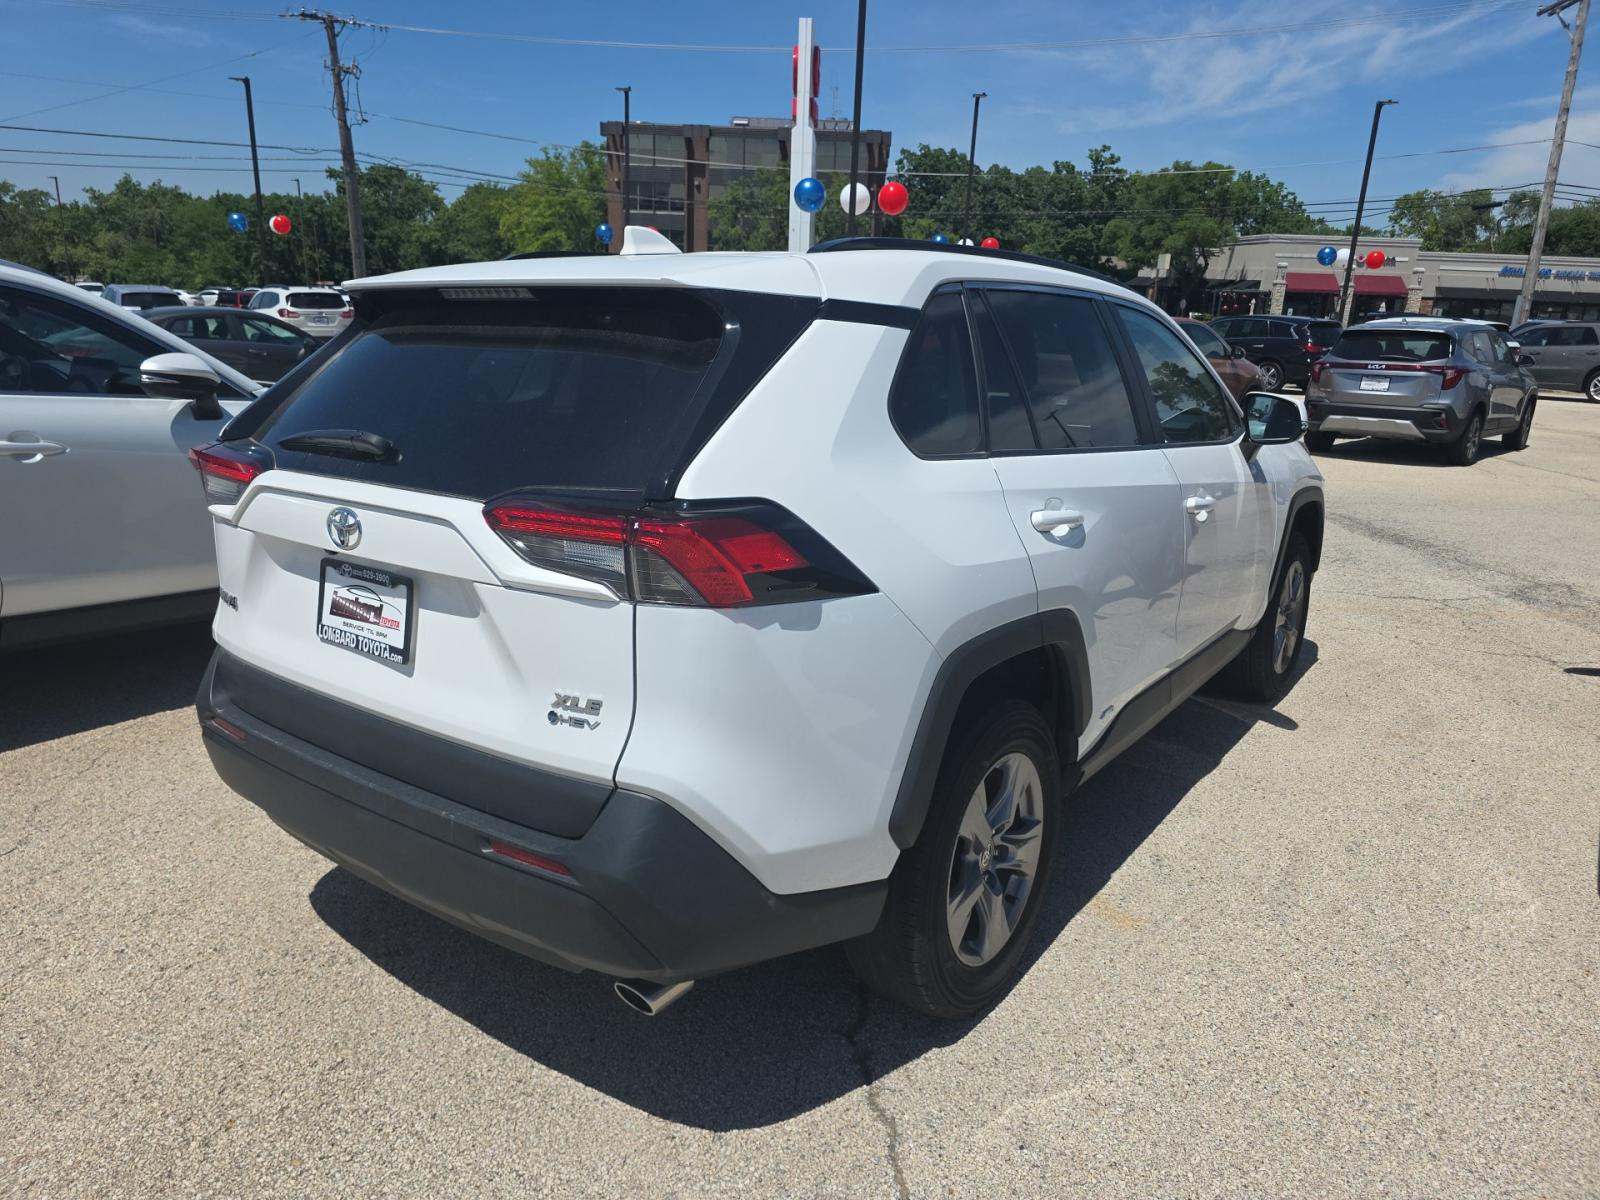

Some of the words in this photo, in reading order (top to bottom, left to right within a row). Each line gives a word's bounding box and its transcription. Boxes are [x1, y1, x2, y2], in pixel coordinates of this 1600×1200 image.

[343, 621, 364, 632] SERVICE
[319, 624, 356, 647] LOMBARD
[359, 636, 402, 663] TOYOTA.com
[551, 692, 603, 716] XLE
[559, 714, 602, 731] HEV
